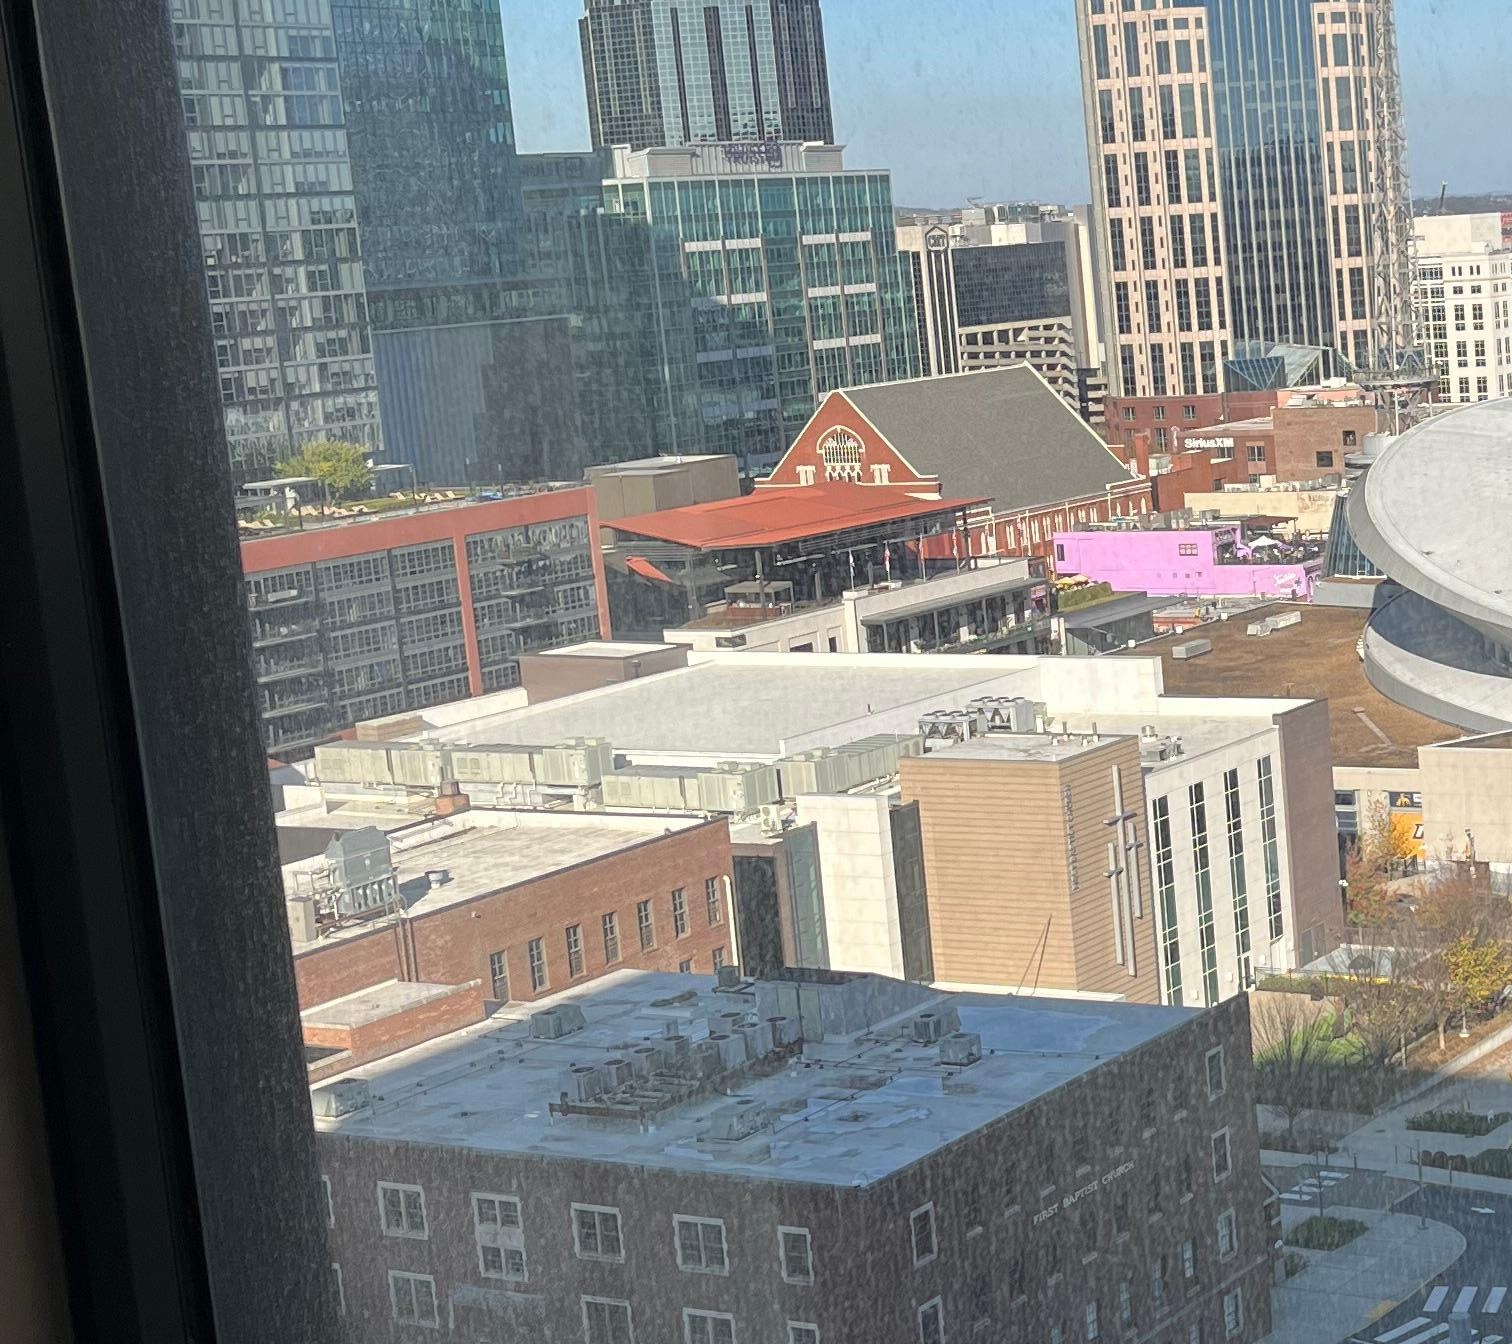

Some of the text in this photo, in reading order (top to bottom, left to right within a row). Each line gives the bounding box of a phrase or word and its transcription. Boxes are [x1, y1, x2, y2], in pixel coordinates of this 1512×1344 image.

[1184, 437, 1234, 449] SiriusXM
[1033, 1161, 1135, 1225] FIRST BAPTIST CHURCH
